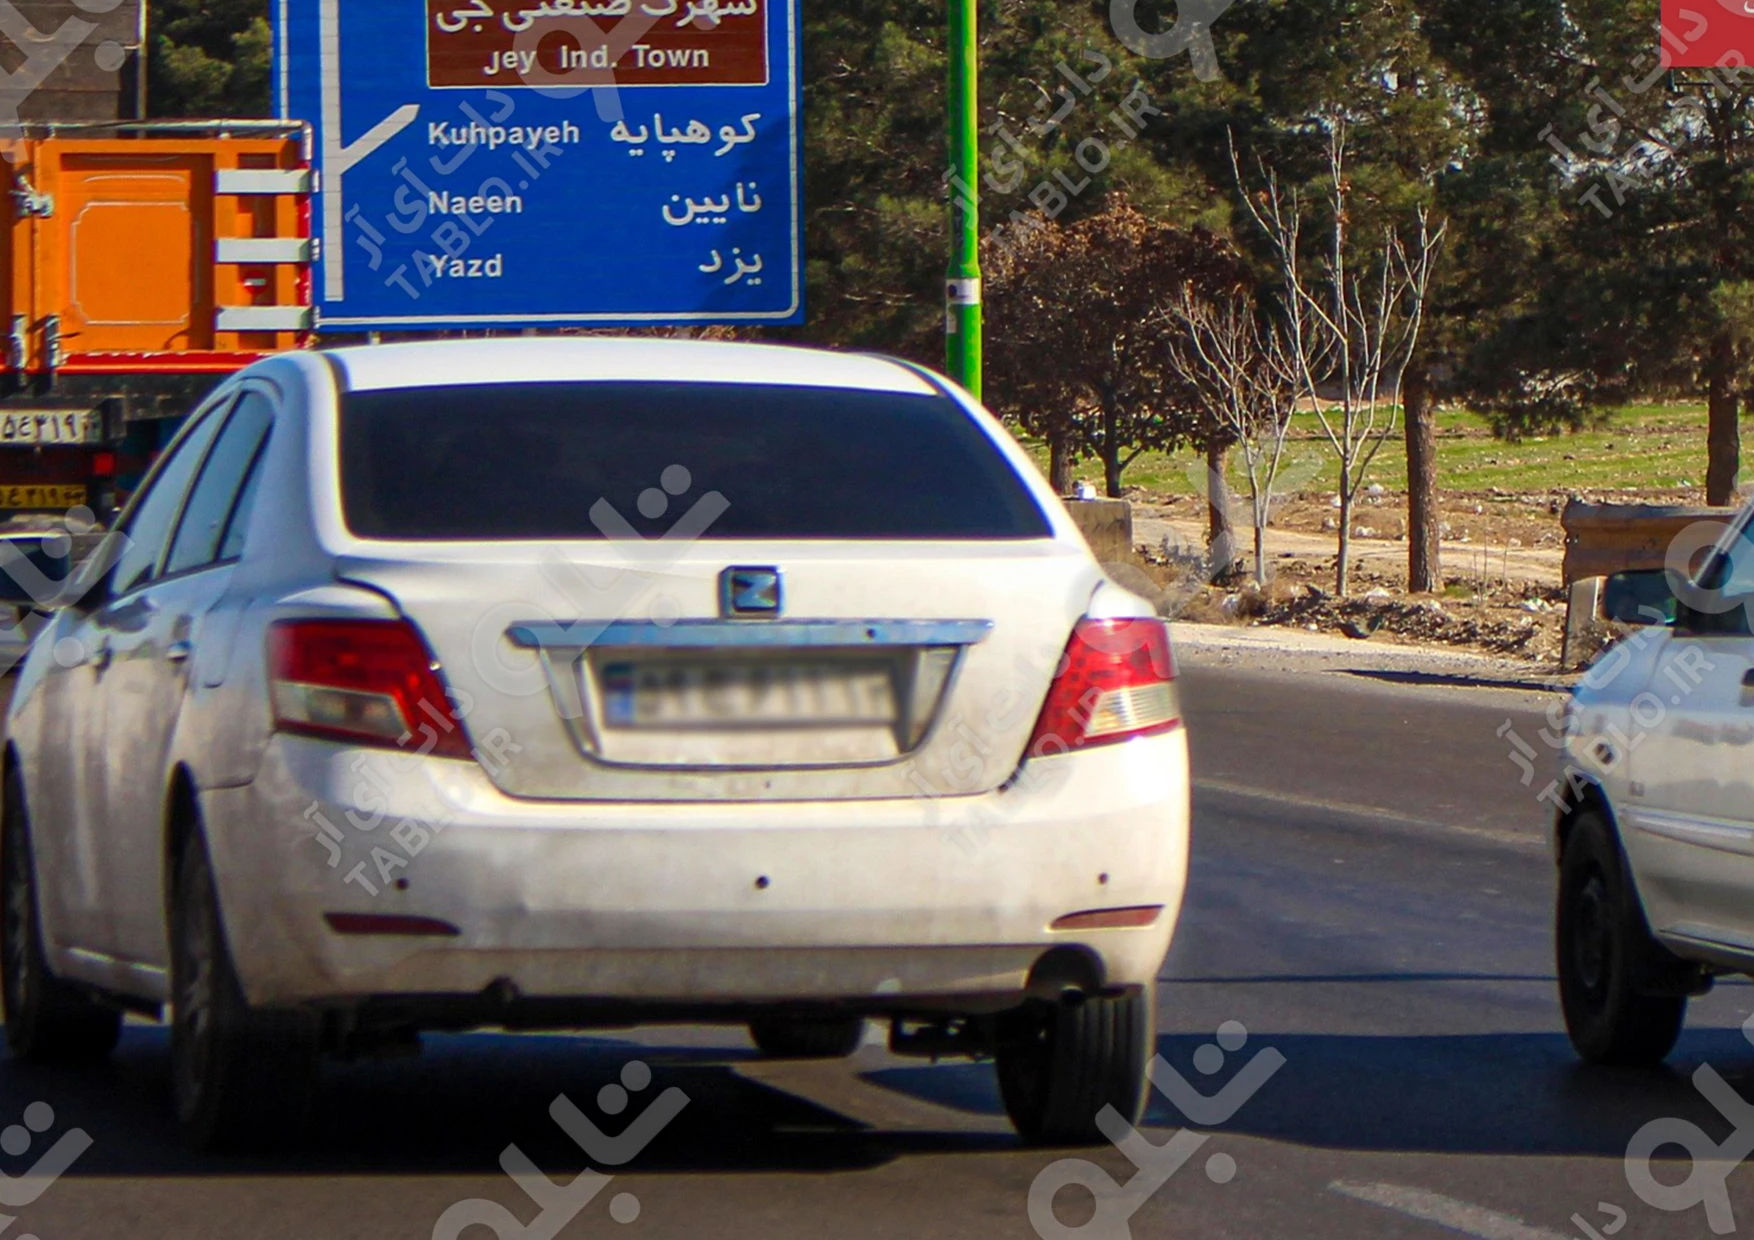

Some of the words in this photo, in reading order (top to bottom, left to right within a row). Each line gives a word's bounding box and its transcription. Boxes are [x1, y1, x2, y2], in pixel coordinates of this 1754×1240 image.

[483, 47, 537, 75] Jey
[561, 46, 618, 69] Ind.
[631, 45, 710, 69] Town
[427, 120, 581, 148] Kuhpayeh
[608, 112, 761, 162] کوهپایه
[427, 191, 523, 214] Naeen
[660, 181, 763, 226] نایین
[428, 254, 503, 278] Yazd
[697, 247, 763, 286] یزد
